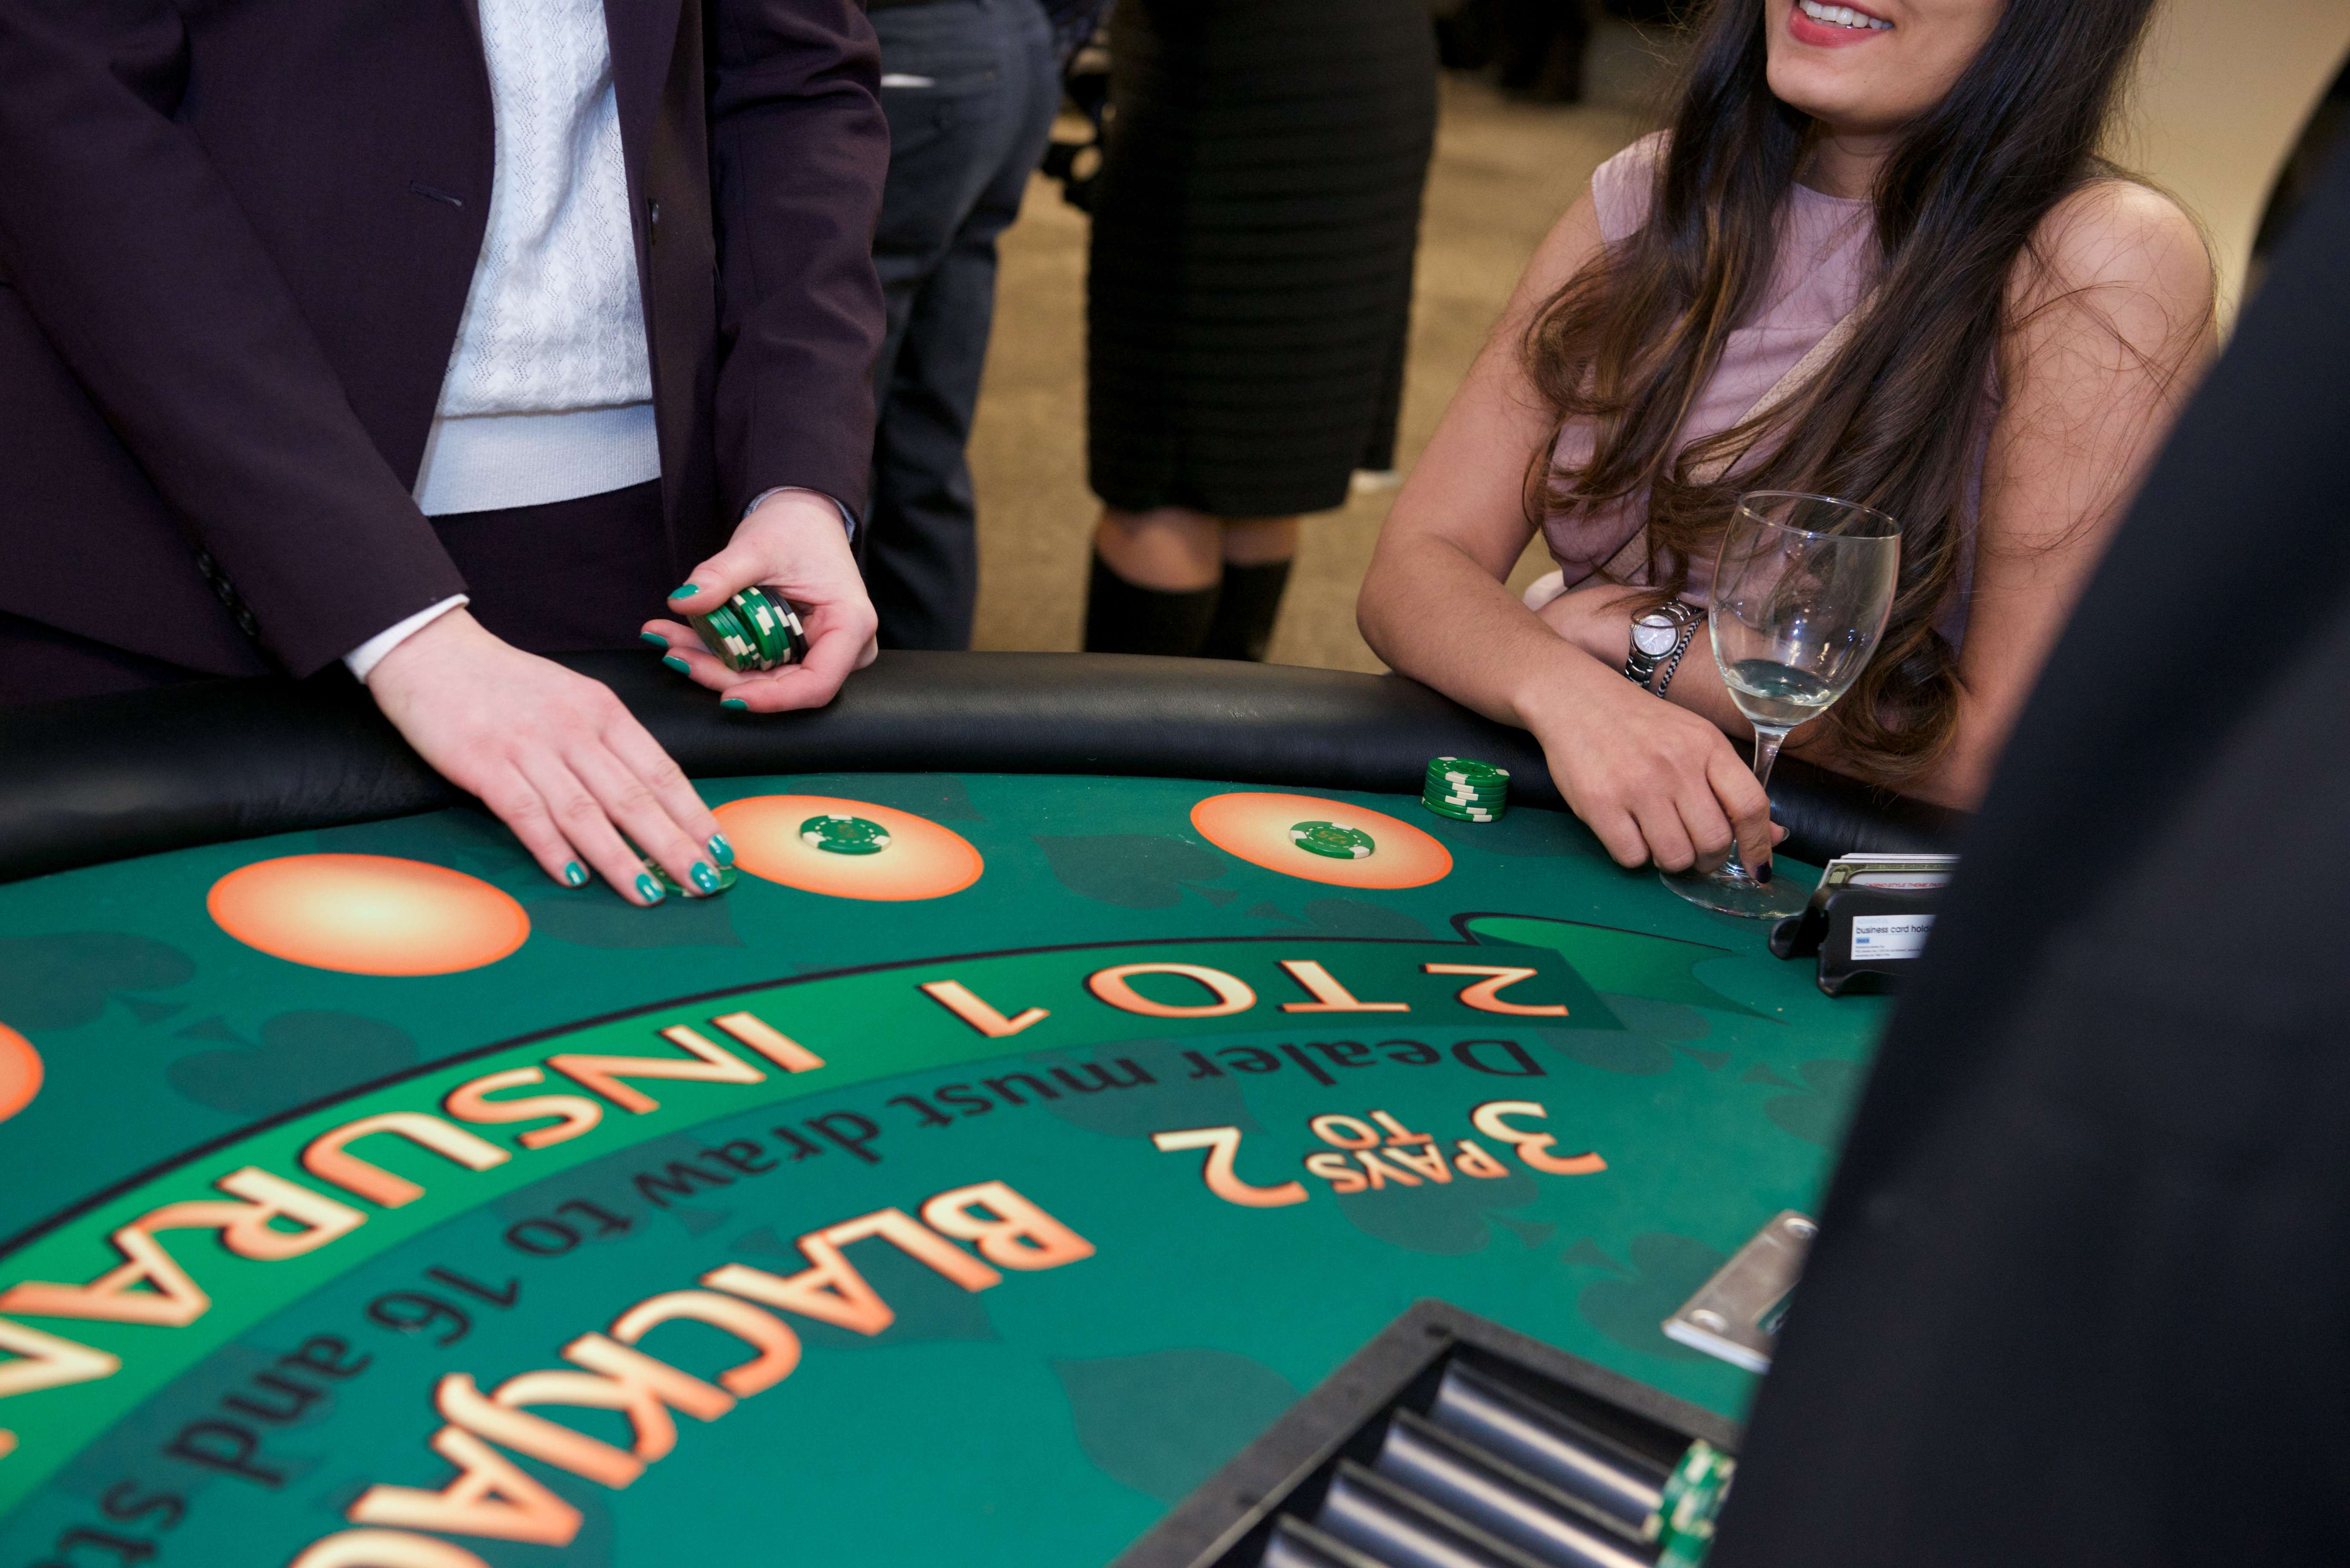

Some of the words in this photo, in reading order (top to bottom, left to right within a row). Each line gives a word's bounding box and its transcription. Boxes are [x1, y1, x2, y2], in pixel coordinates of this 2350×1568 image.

[917, 979, 1051, 1038] 1
[1085, 960, 1411, 1018] TO
[1420, 962, 1570, 1016] 2
[1184, 1039, 1548, 1087] Dealer
[886, 1058, 1158, 1128] must
[1309, 1110, 1433, 1150] TO
[1470, 1100, 1608, 1175] 3
[632, 1111, 882, 1209] draw
[1150, 1126, 1310, 1208] 2
[1303, 1139, 1510, 1193] PAYS
[504, 1199, 634, 1256] to
[365, 1267, 520, 1348] 16
[163, 1335, 373, 1490] and
